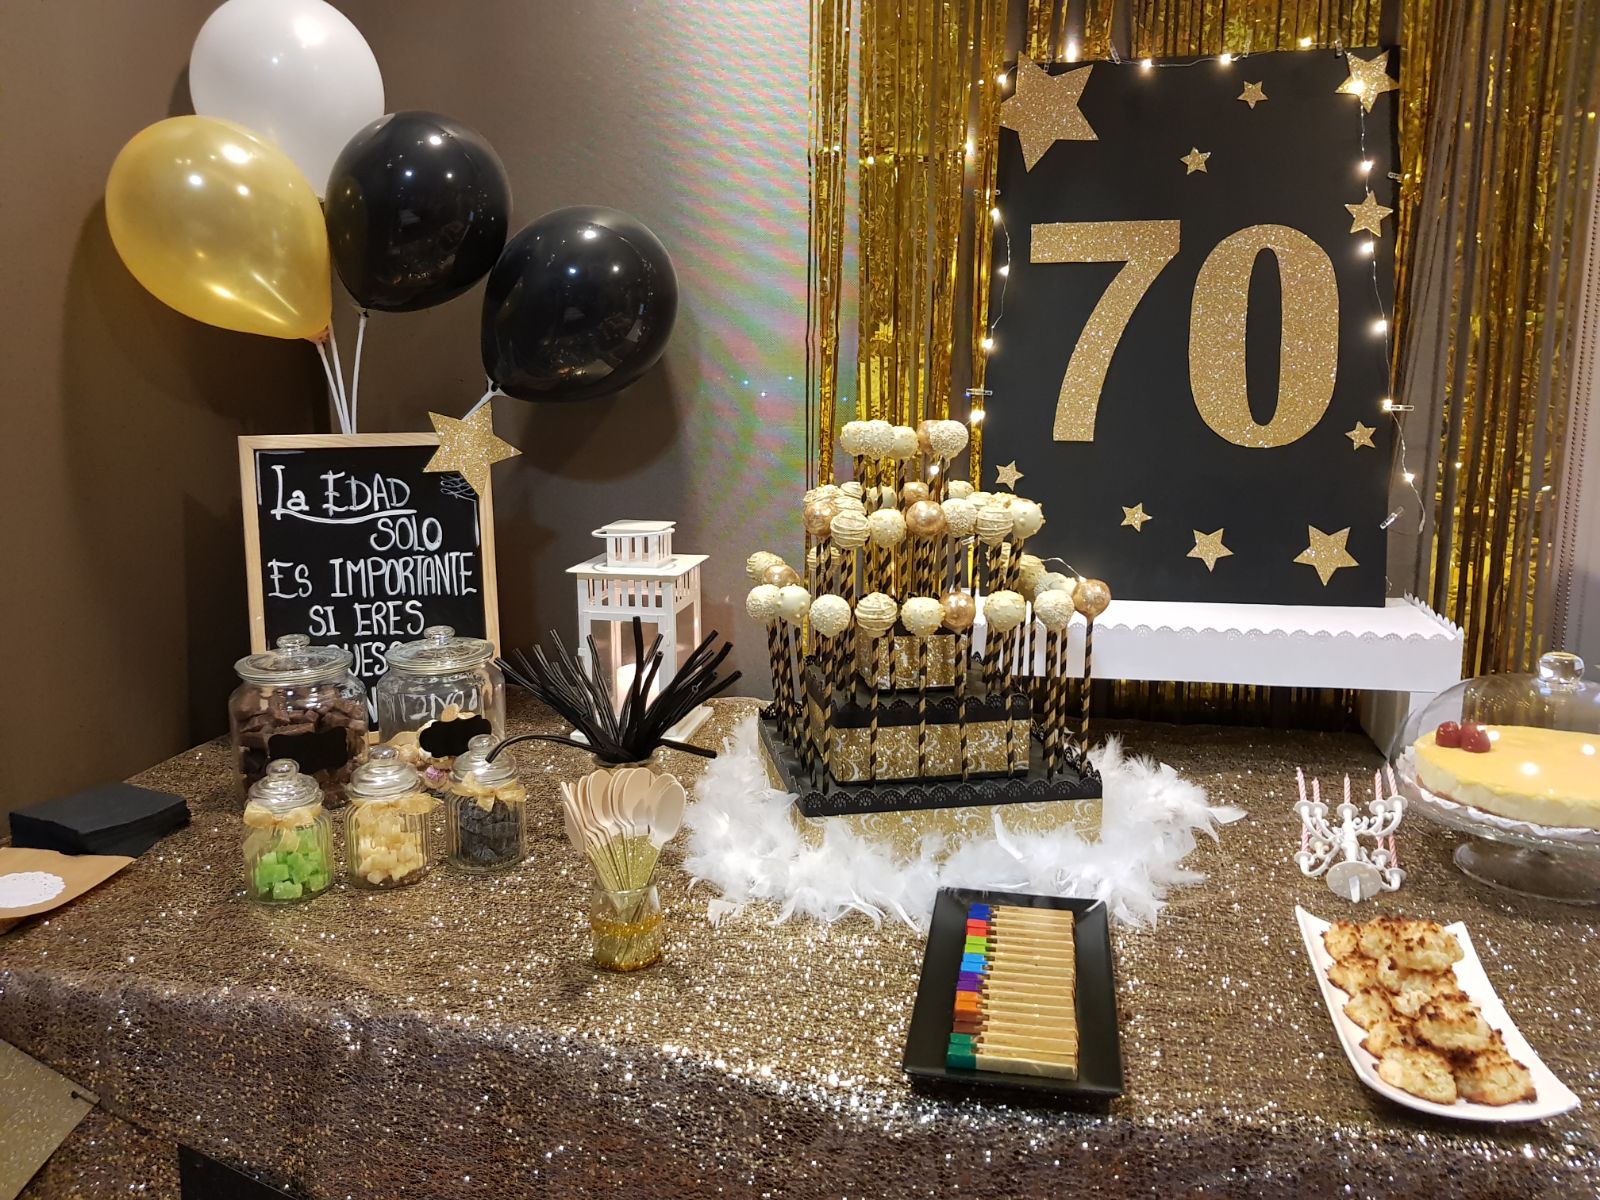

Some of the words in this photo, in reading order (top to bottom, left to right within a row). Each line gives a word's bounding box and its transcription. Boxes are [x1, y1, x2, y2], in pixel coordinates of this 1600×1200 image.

[1030, 220, 1340, 449] 70
[271, 465, 310, 520] La
[320, 470, 411, 517] EDAD
[370, 516, 443, 552] SOLO
[329, 551, 477, 599] IMPORTANTE
[308, 605, 342, 637] SI
[353, 600, 426, 637] ERES
[326, 641, 402, 678] UES
